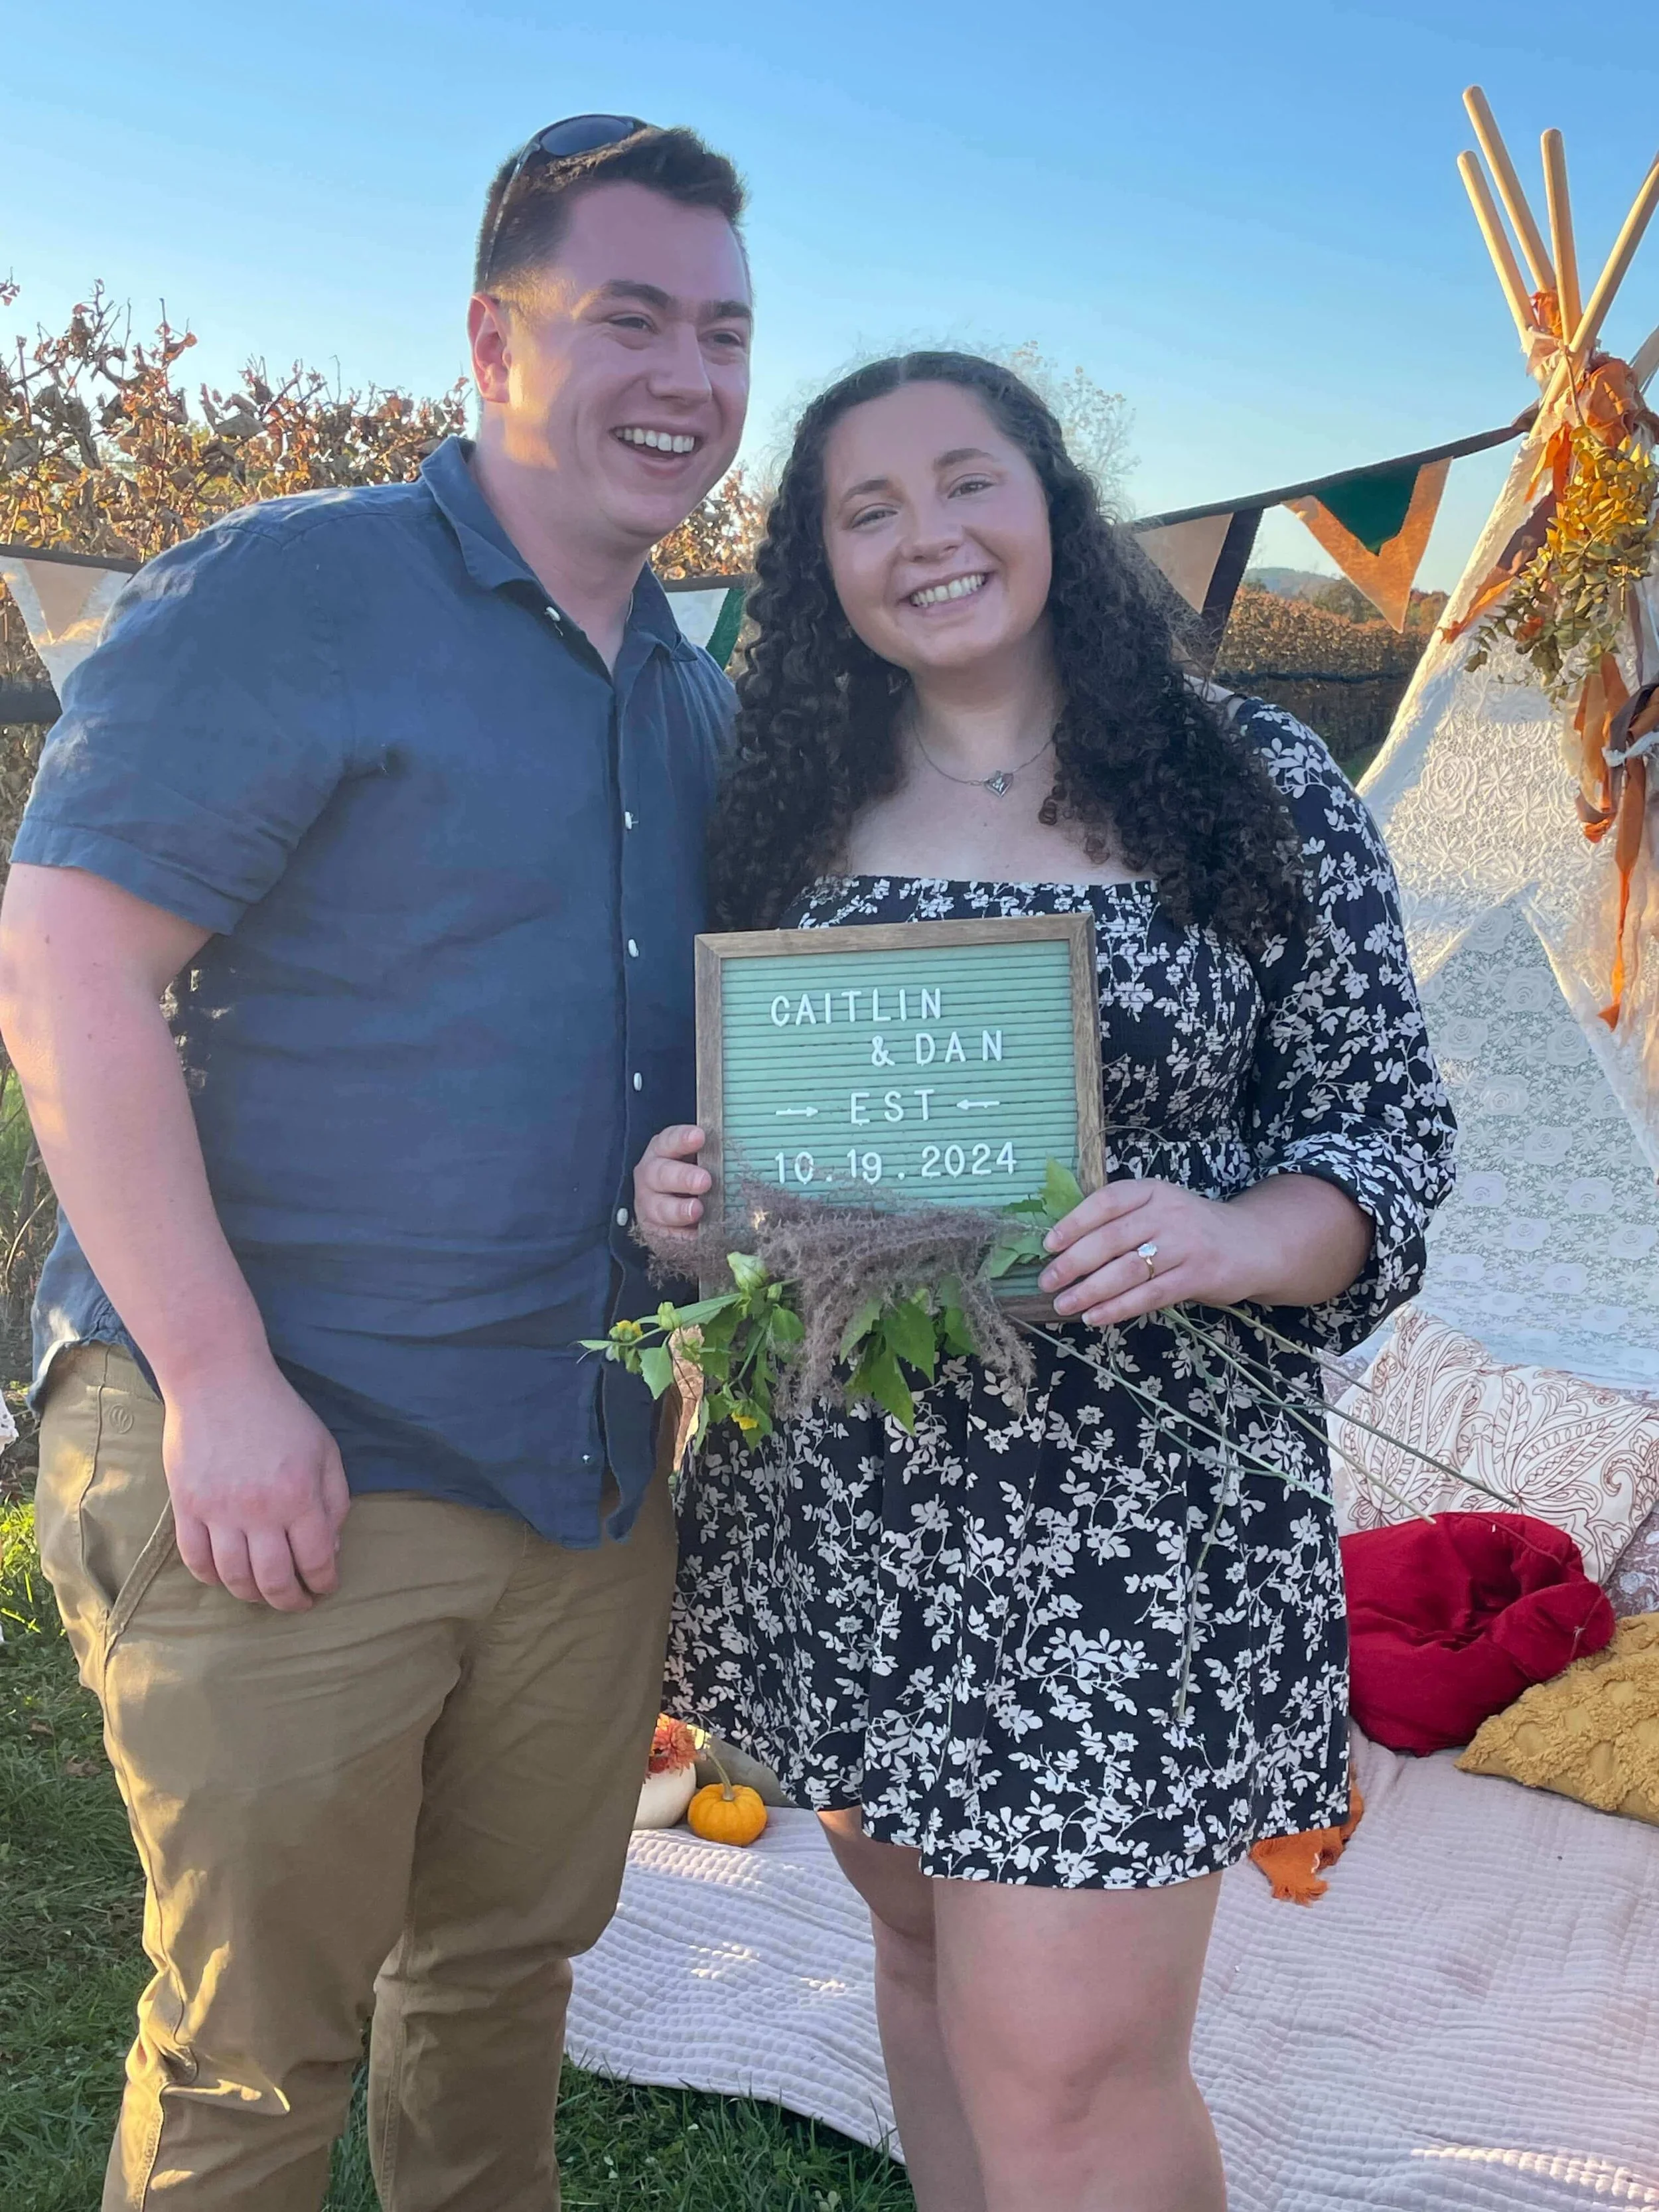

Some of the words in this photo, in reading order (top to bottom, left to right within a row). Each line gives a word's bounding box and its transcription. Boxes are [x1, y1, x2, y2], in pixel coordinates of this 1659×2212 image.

[770, 988, 942, 1027] CAITLIN
[871, 1035, 896, 1068] &
[915, 1029, 1003, 1067] DAN
[850, 1088, 935, 1126] EST
